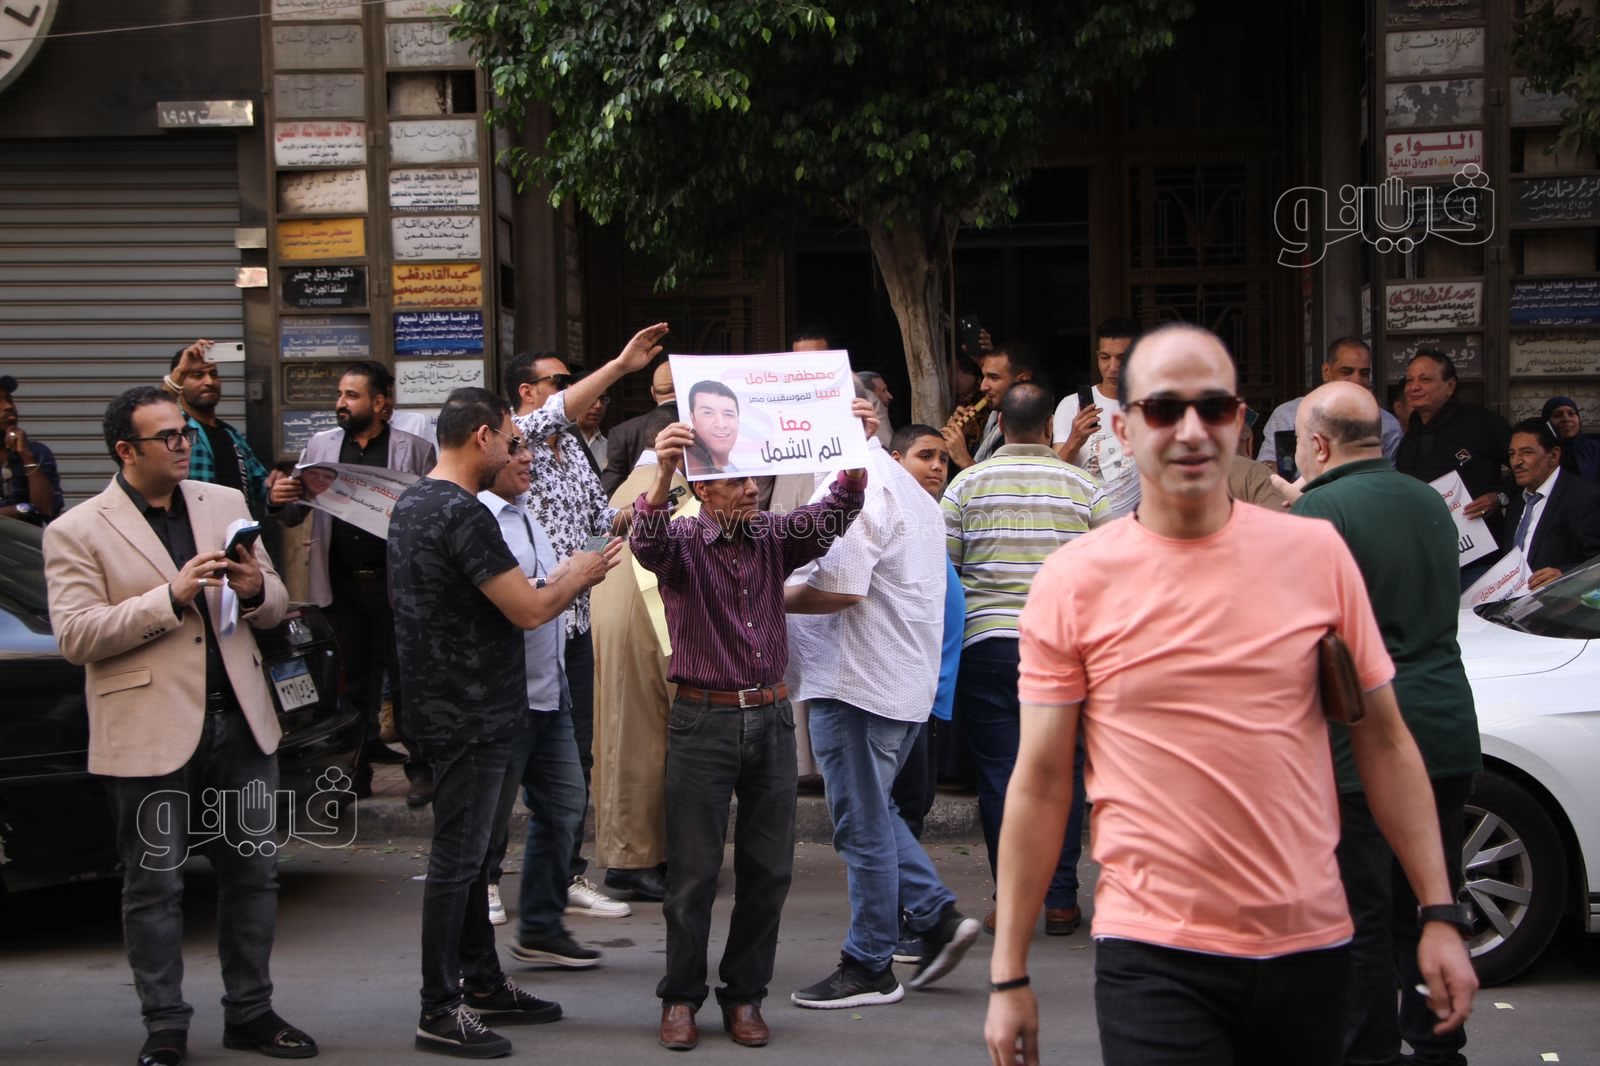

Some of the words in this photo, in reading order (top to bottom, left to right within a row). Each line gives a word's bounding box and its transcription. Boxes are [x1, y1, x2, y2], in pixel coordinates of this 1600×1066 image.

[1393, 132, 1473, 156] اللواء
[744, 370, 779, 385] كامل
[761, 436, 814, 464] الشمل
[818, 435, 843, 463] للم
